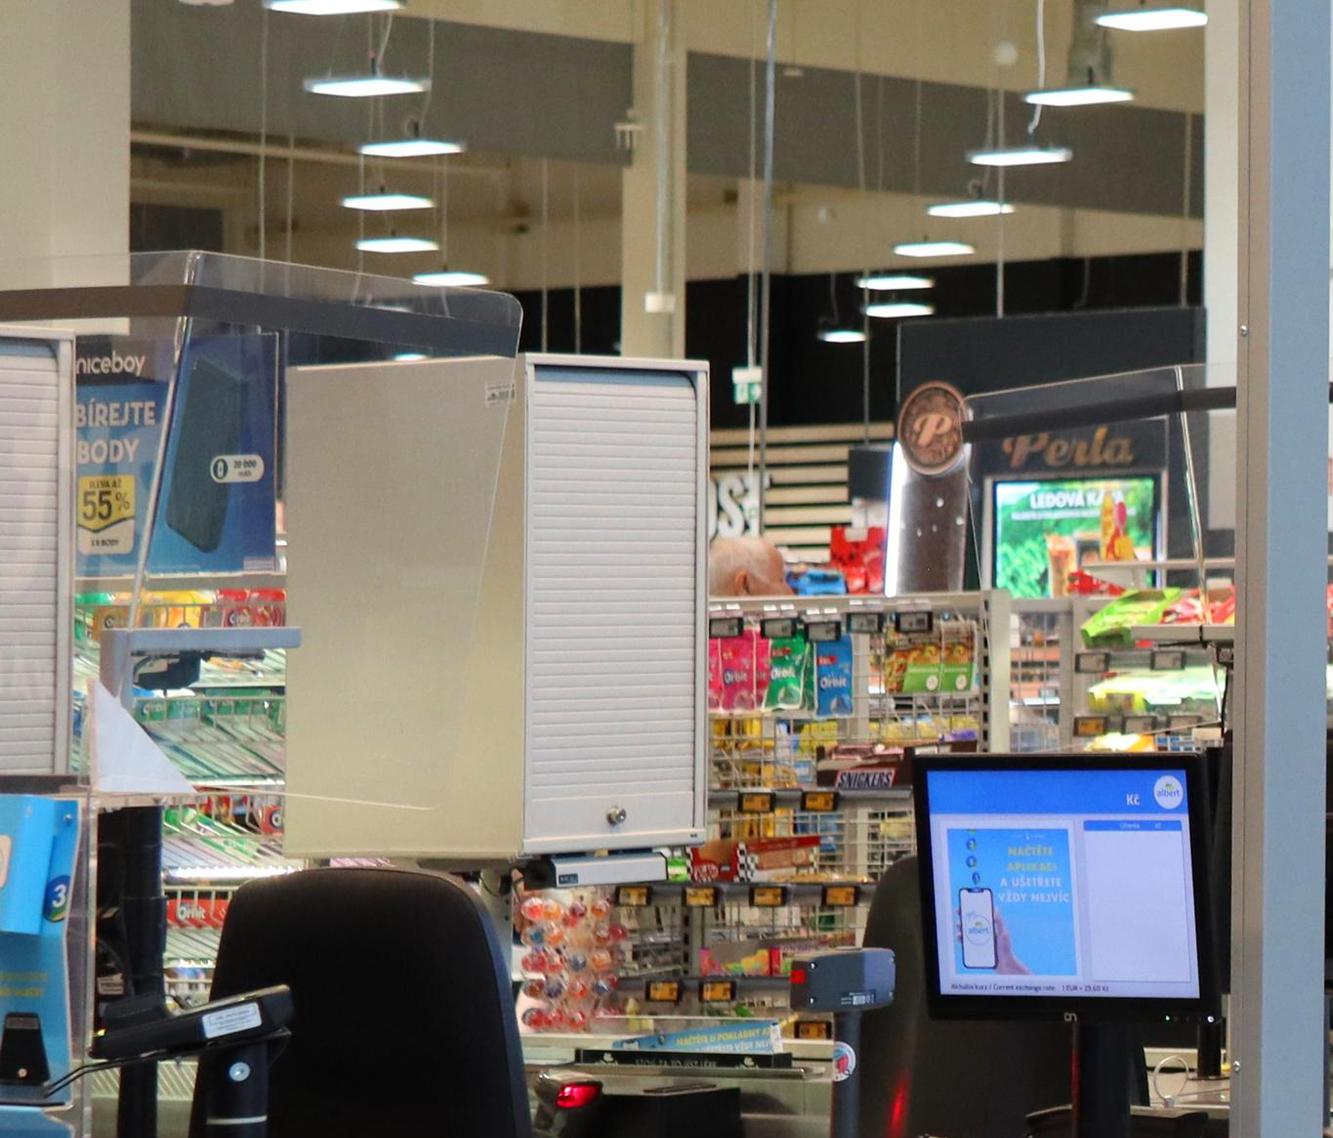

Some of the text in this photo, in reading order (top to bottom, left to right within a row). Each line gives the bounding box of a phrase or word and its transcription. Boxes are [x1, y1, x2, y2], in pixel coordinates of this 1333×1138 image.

[76, 351, 145, 376] niceboy
[77, 399, 156, 427] BÍREJTE
[78, 440, 140, 464] BODY
[1002, 425, 1134, 468] Perla
[820, 676, 848, 689] Orbit
[838, 770, 894, 787] SNICKERS
[1126, 793, 1140, 806] Kč
[52, 883, 67, 908] 3
